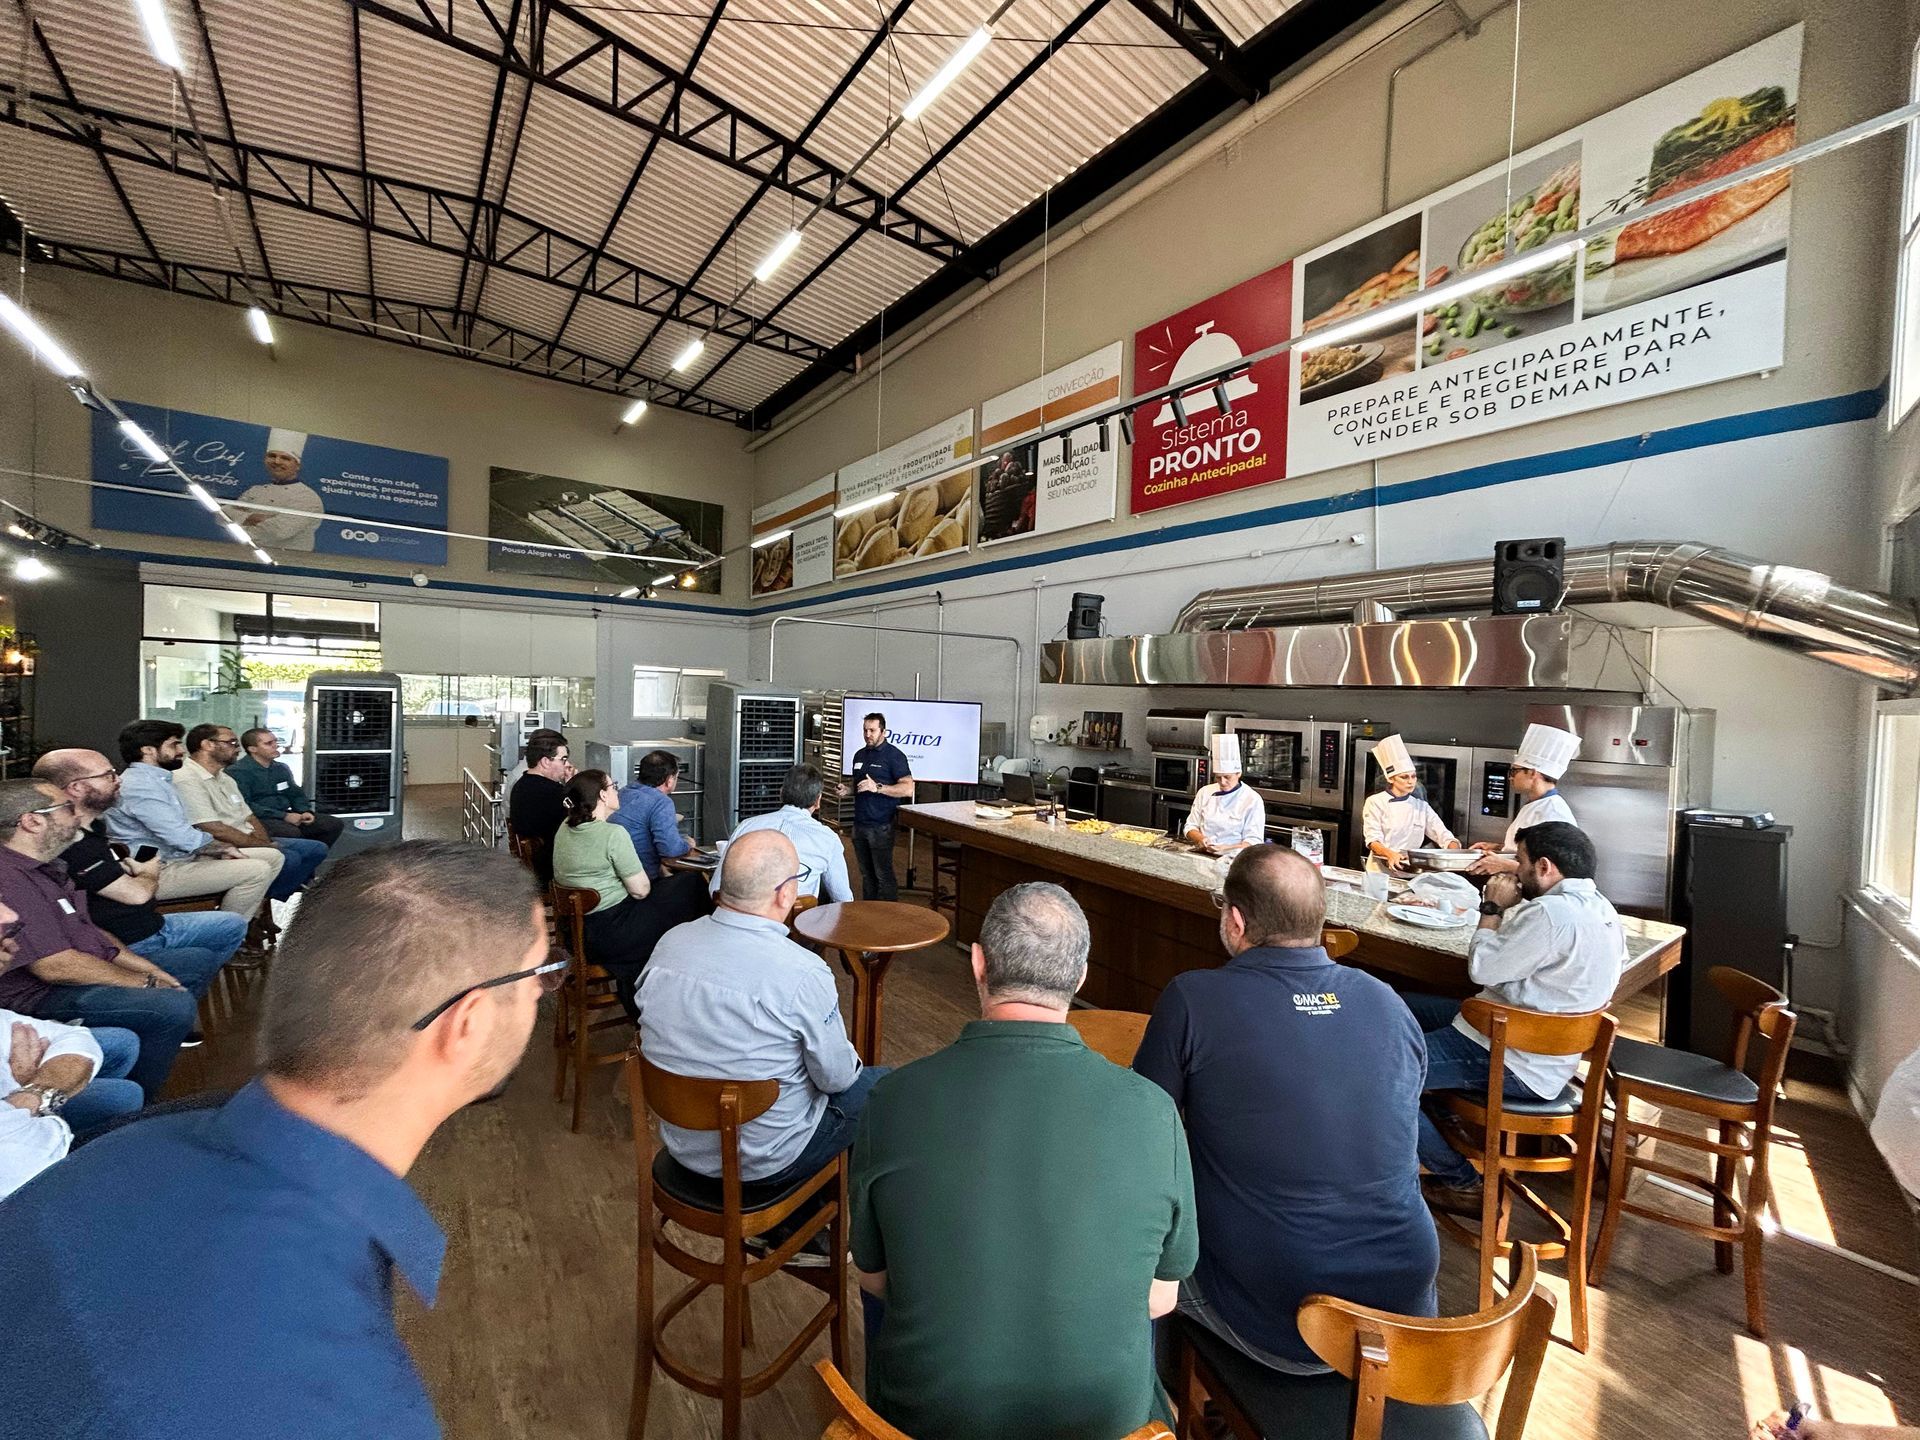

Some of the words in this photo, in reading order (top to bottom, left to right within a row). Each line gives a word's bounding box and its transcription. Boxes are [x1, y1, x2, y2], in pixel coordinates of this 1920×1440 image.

[1327, 385, 1419, 421] PREPARE
[1429, 301, 1725, 394] ANTECIPADAMENTE,
[1047, 367, 1104, 400] CONVECÇÃO
[1333, 400, 1428, 436] CONGELE
[1440, 394, 1451, 408] E
[1463, 352, 1608, 402] REGENERE
[1624, 326, 1712, 361] PARA
[1353, 416, 1439, 447] VENDER
[1449, 401, 1497, 424] SOB
[1510, 357, 1671, 409] DEMANDA!
[1161, 409, 1248, 450] Sistema
[193, 440, 246, 467] Chef
[1043, 454, 1061, 467] MAIS
[1050, 456, 1090, 477] PRODUÇÃO
[1091, 454, 1097, 465] E
[1149, 427, 1262, 480] PRONTO
[341, 471, 371, 483] Conte
[372, 476, 394, 486] com
[395, 480, 420, 490] chefs
[1047, 474, 1071, 489] LUCRO
[1072, 468, 1091, 481] PARA
[1092, 466, 1099, 476] O
[1143, 477, 1188, 495] Cozinha
[1190, 453, 1267, 484] Antecipada!
[319, 477, 379, 493] experientes,
[381, 486, 417, 497] prontos
[418, 491, 439, 501] para
[321, 485, 353, 495] ajudar
[354, 490, 378, 499] você
[379, 493, 392, 501] na
[393, 496, 438, 508] operação!
[1047, 488, 1061, 501] SEU
[502, 546, 526, 555] Pouso
[527, 549, 552, 558] Alegre
[558, 552, 571, 560] MG
